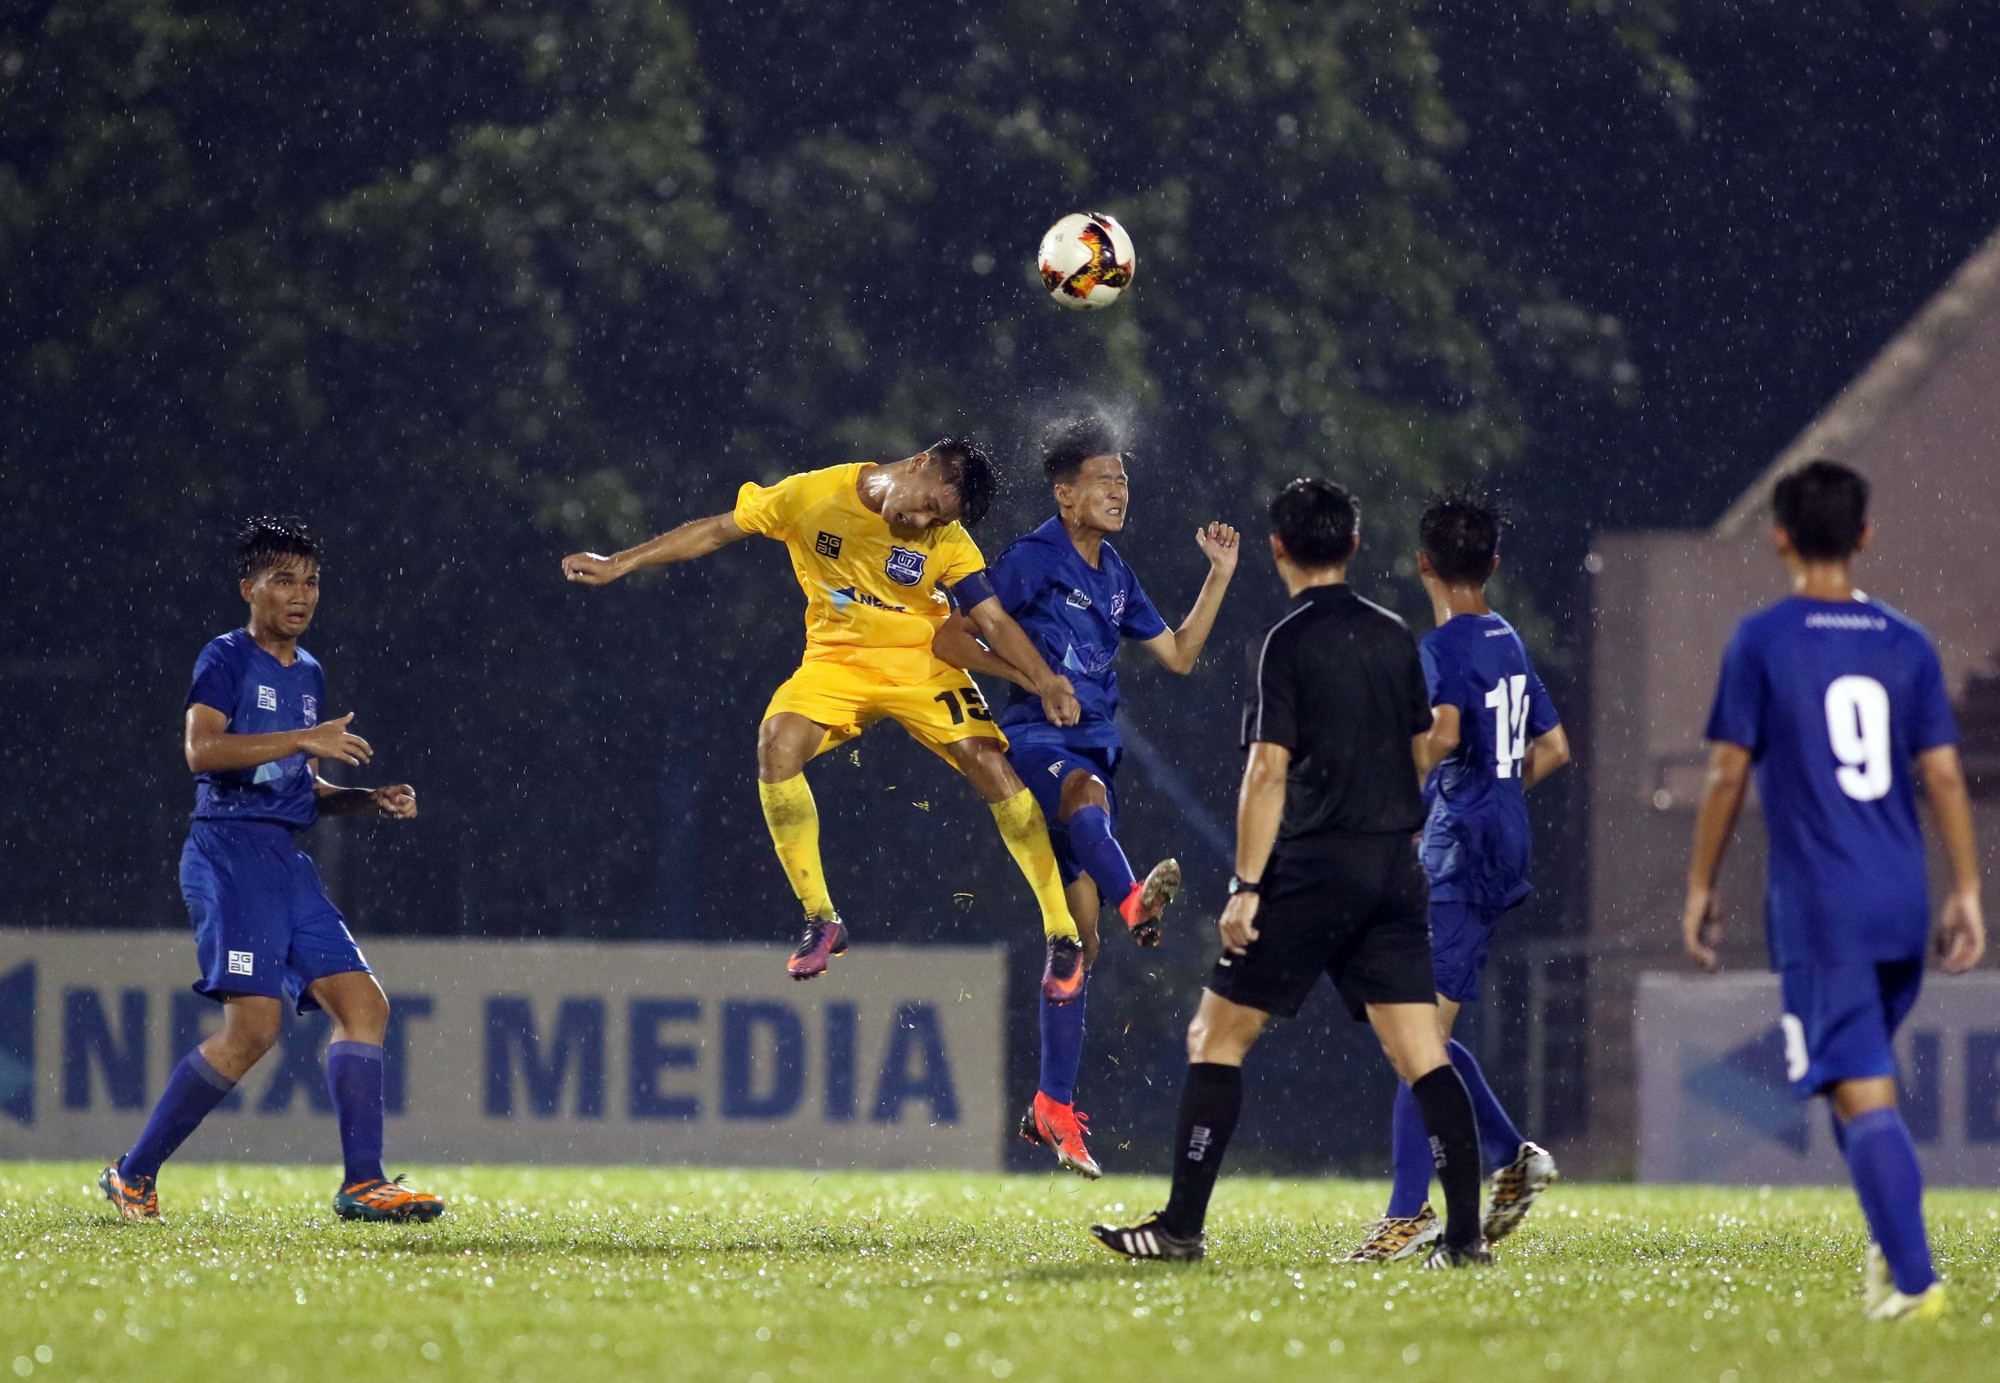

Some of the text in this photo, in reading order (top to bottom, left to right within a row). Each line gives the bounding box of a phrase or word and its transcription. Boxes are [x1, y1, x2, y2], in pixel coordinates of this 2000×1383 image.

[934, 687, 992, 725] 15
[1484, 674, 1530, 779] 14
[1824, 675, 1892, 801] 9
[482, 995, 960, 1124] MEDIA
[1187, 1125, 1213, 1161] mitre
